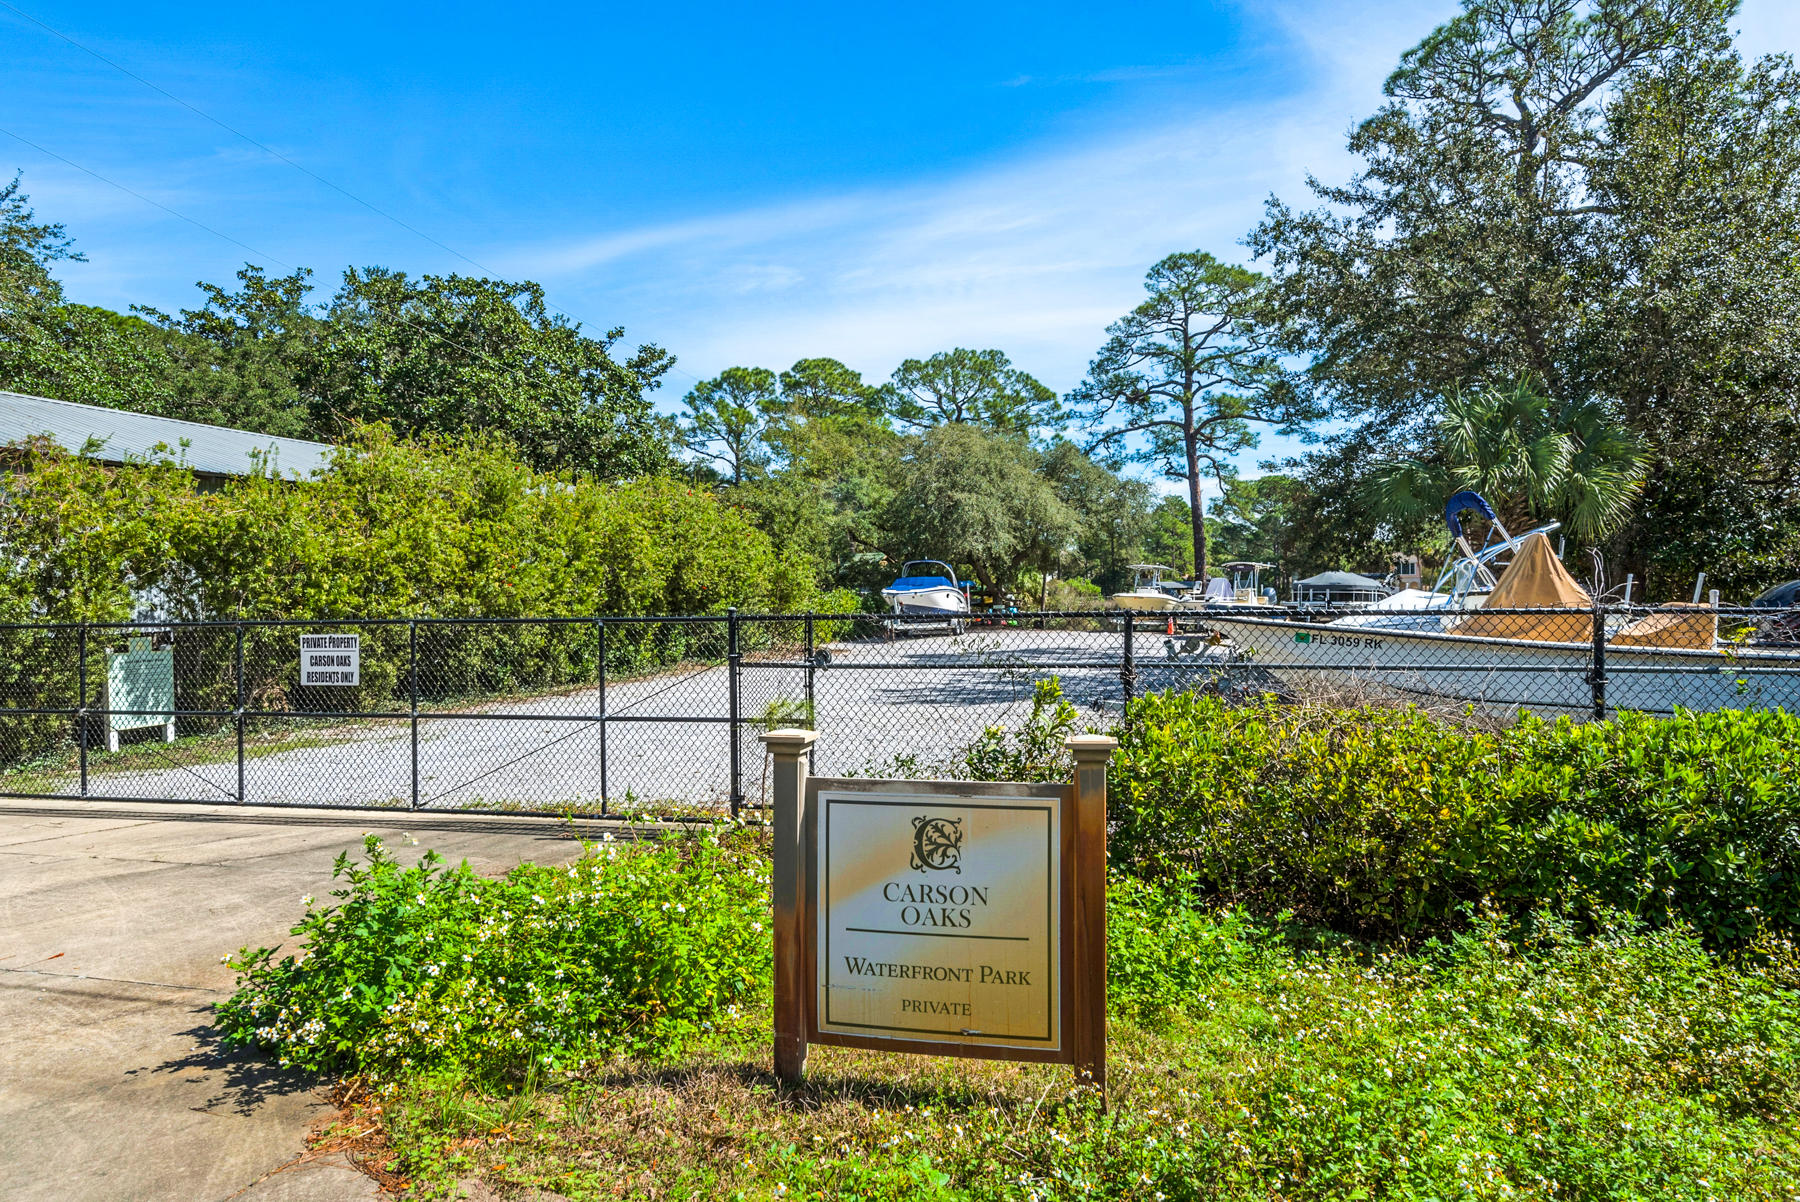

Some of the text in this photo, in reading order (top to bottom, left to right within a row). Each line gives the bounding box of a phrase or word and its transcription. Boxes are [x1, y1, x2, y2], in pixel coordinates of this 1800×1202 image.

[302, 636, 357, 648] PRIVATE PROPERTY
[1311, 634, 1383, 649] FL 3059 RK
[310, 655, 351, 667] CARSON OAKS
[307, 672, 354, 683] RESIDENTS ONLY
[883, 882, 989, 906] CARSON
[900, 905, 972, 929] OAKS
[844, 955, 1031, 986] WATERFRONT PARK
[901, 998, 972, 1016] PRIVATE
